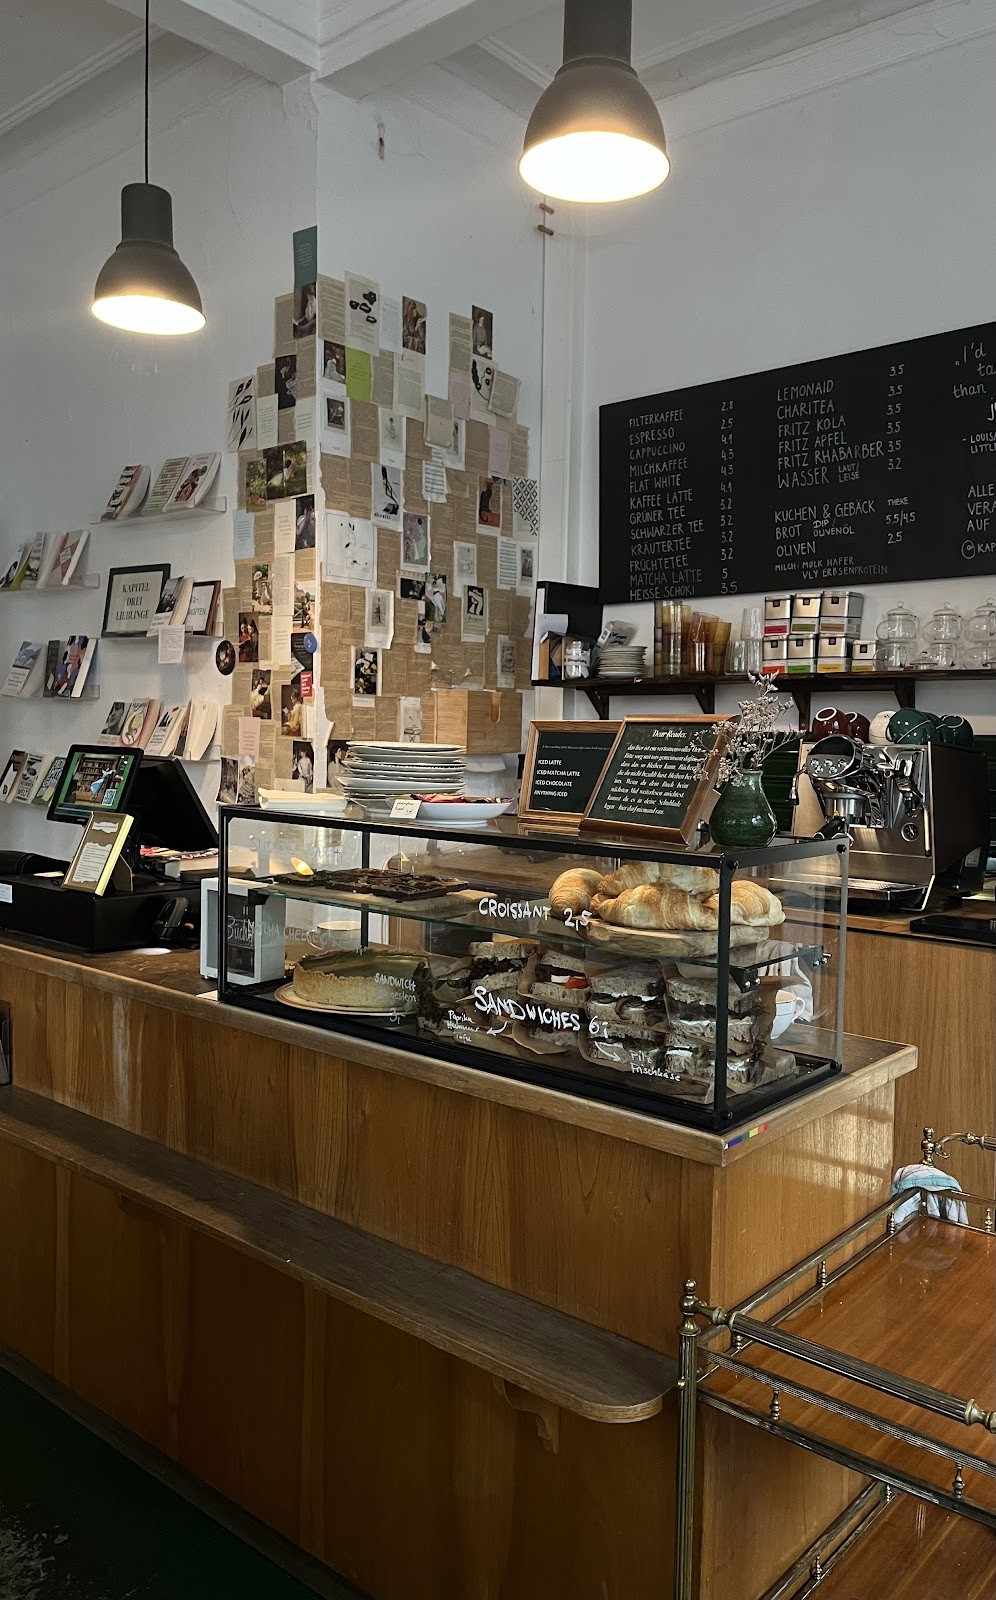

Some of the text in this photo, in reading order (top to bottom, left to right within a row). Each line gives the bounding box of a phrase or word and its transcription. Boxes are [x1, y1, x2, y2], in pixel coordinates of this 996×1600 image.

[977, 362, 996, 377] ta
[777, 363, 905, 402] LEMONAID 3.5
[953, 383, 987, 399] than
[777, 384, 903, 420] CHARITEA 3.5
[629, 409, 683, 428] FILTERKAFFEE
[778, 403, 902, 438] FRITZ KOLA 3.5
[629, 417, 733, 446] ESPRESSO 2.5
[778, 421, 901, 454] FRITZ APFEL 3.5
[629, 433, 733, 460] CAPPUCCINO 4.1
[778, 439, 902, 471] FRITZ RHABARBER 3.5
[629, 457, 688, 477] MILCHKAFFEE
[777, 457, 902, 489] WASSER LAUT/ 3.2
[838, 470, 860, 483] LEISE
[629, 479, 650, 493] FLAT
[654, 474, 682, 489] WHITE
[967, 483, 995, 498] ALLE
[630, 481, 733, 510] KAFFEE LATTE 4.1
[629, 498, 732, 525] GRÜNER TEE 3.2
[774, 496, 909, 523] KUCHEN & GEBÄCK THEKE
[630, 514, 733, 540] SCHWARZER TEE 3.2
[775, 524, 802, 540] BROT
[813, 524, 855, 537] OLIVENÖL
[966, 518, 990, 532] AUF
[631, 530, 733, 556] KRÄUTERTEE 3.2
[776, 531, 903, 557] OLIVEN 2.5
[629, 548, 733, 573] FRÜCHTETEE 3.2
[827, 556, 854, 566] HAFER
[629, 568, 728, 587] MATCHA LATTE 5
[802, 565, 888, 580] VLY ERBSENPROTEIN
[122, 582, 150, 593] KAPITEL
[629, 581, 738, 601] HEISSE SCHOKI 3.5
[126, 596, 143, 606] DREI
[115, 610, 150, 621] LIEBLINGE
[478, 897, 592, 932] CROISSANT 2,5
[374, 972, 417, 992] SANDWICH
[448, 1010, 476, 1024] Paprika
[473, 985, 582, 1032] SANDWICHES
